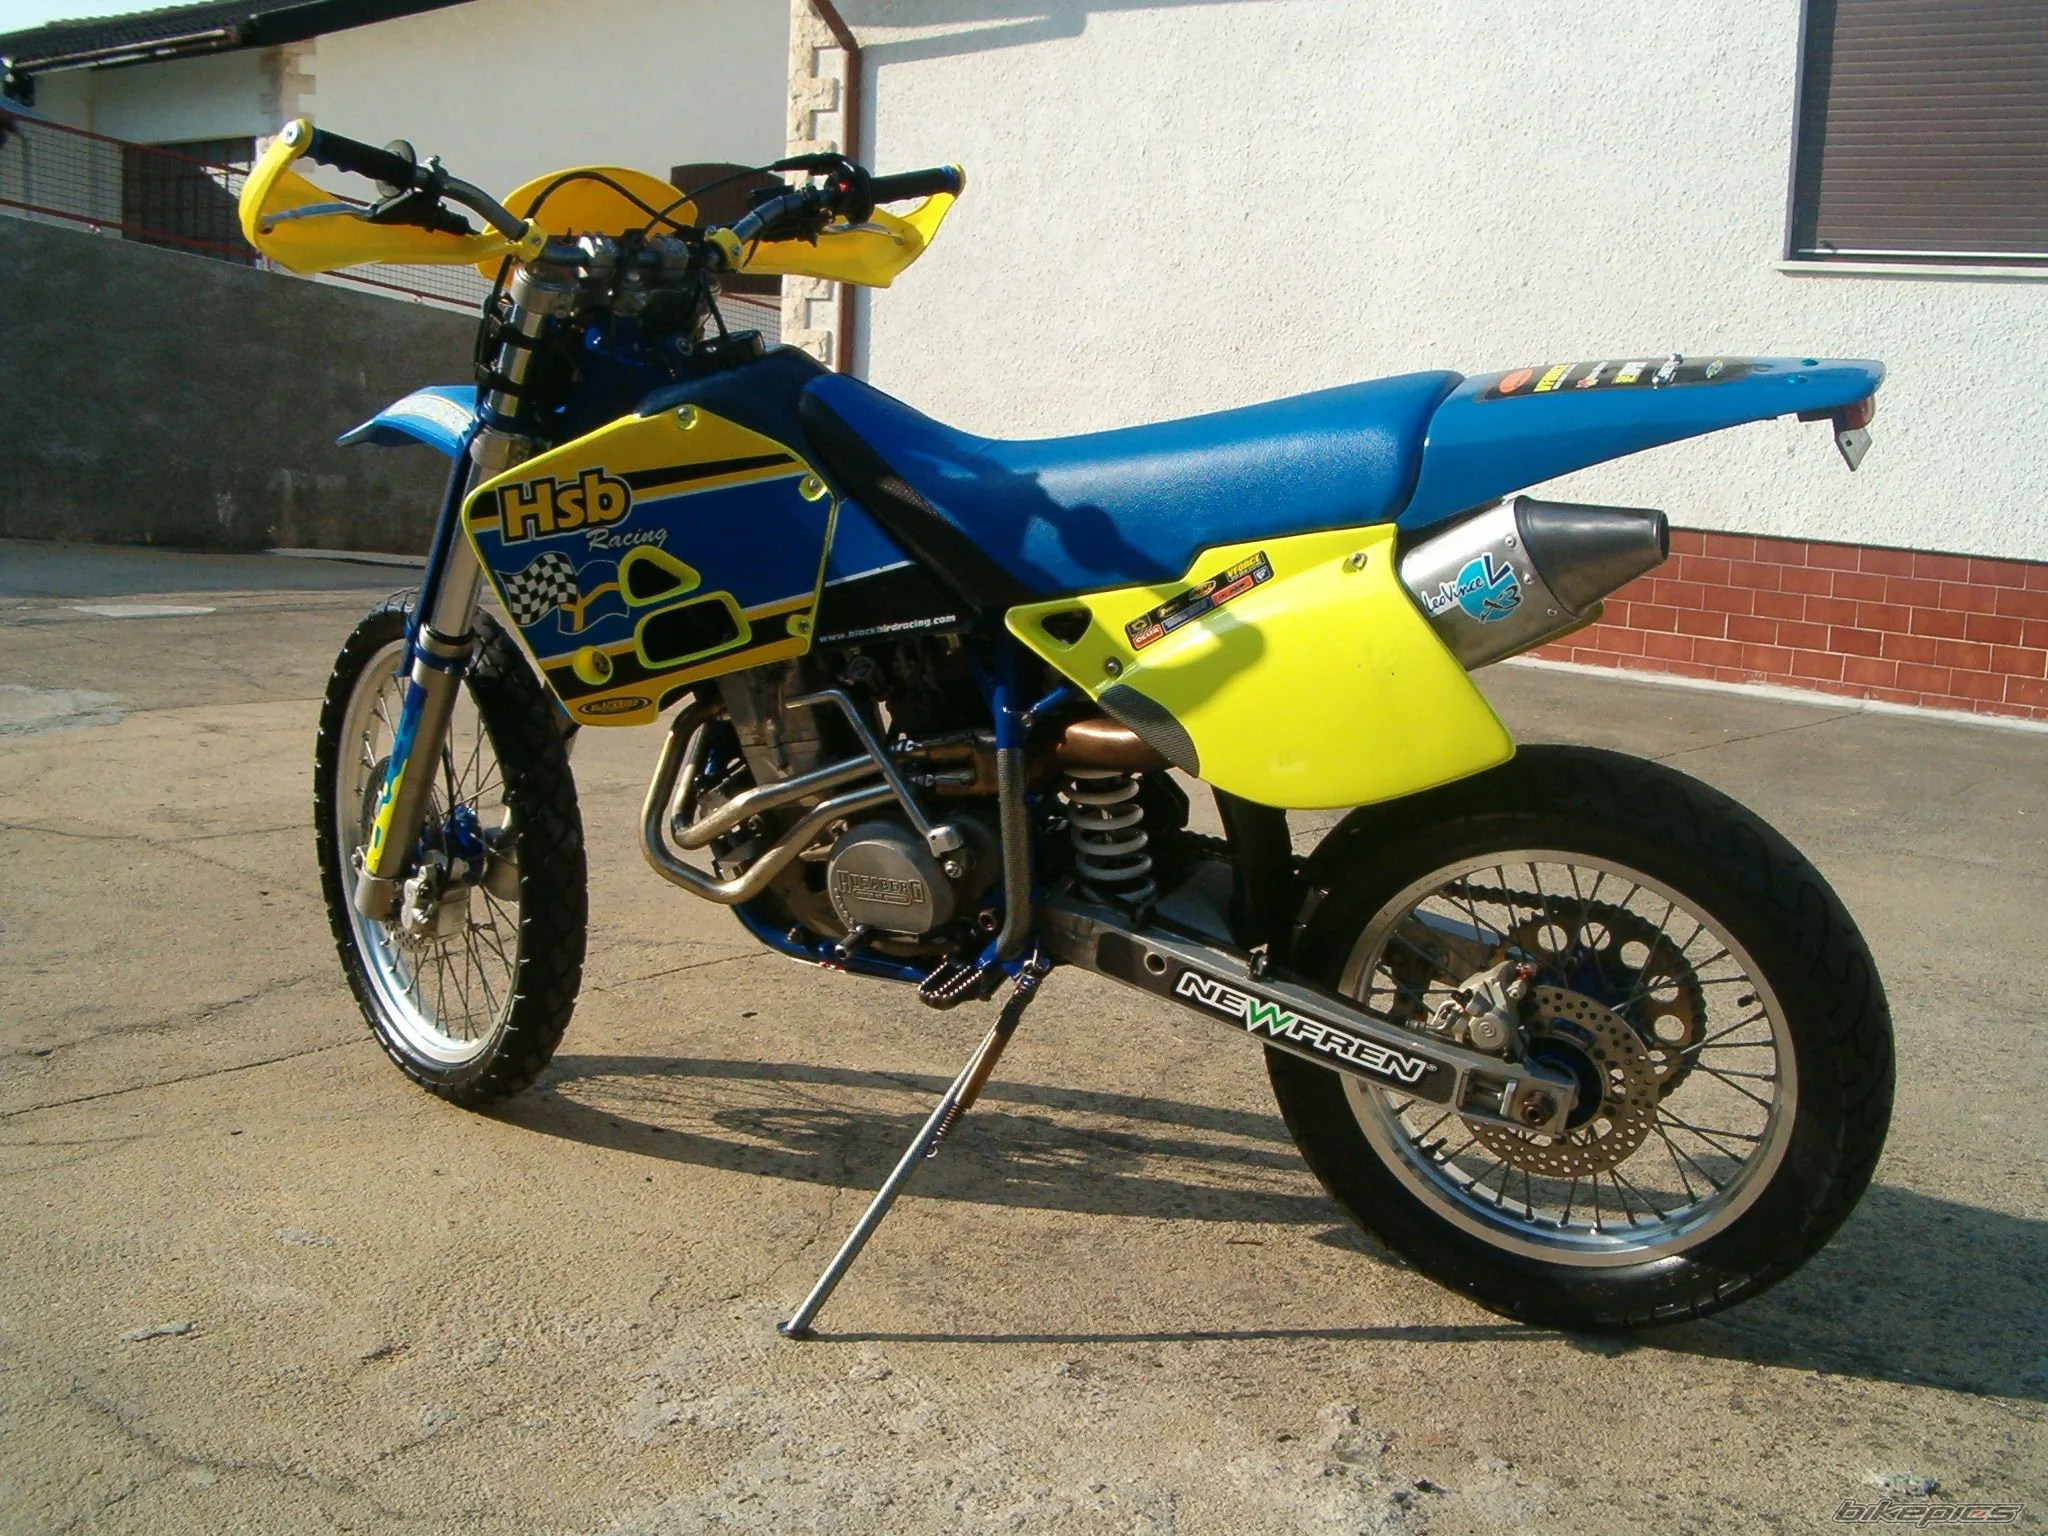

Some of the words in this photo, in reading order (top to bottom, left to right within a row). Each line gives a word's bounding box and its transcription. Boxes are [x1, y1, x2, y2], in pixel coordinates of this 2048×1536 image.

[498, 469, 631, 545] Hsb
[585, 526, 669, 552] Racing
[1176, 971, 1428, 1083] NEWFREN
